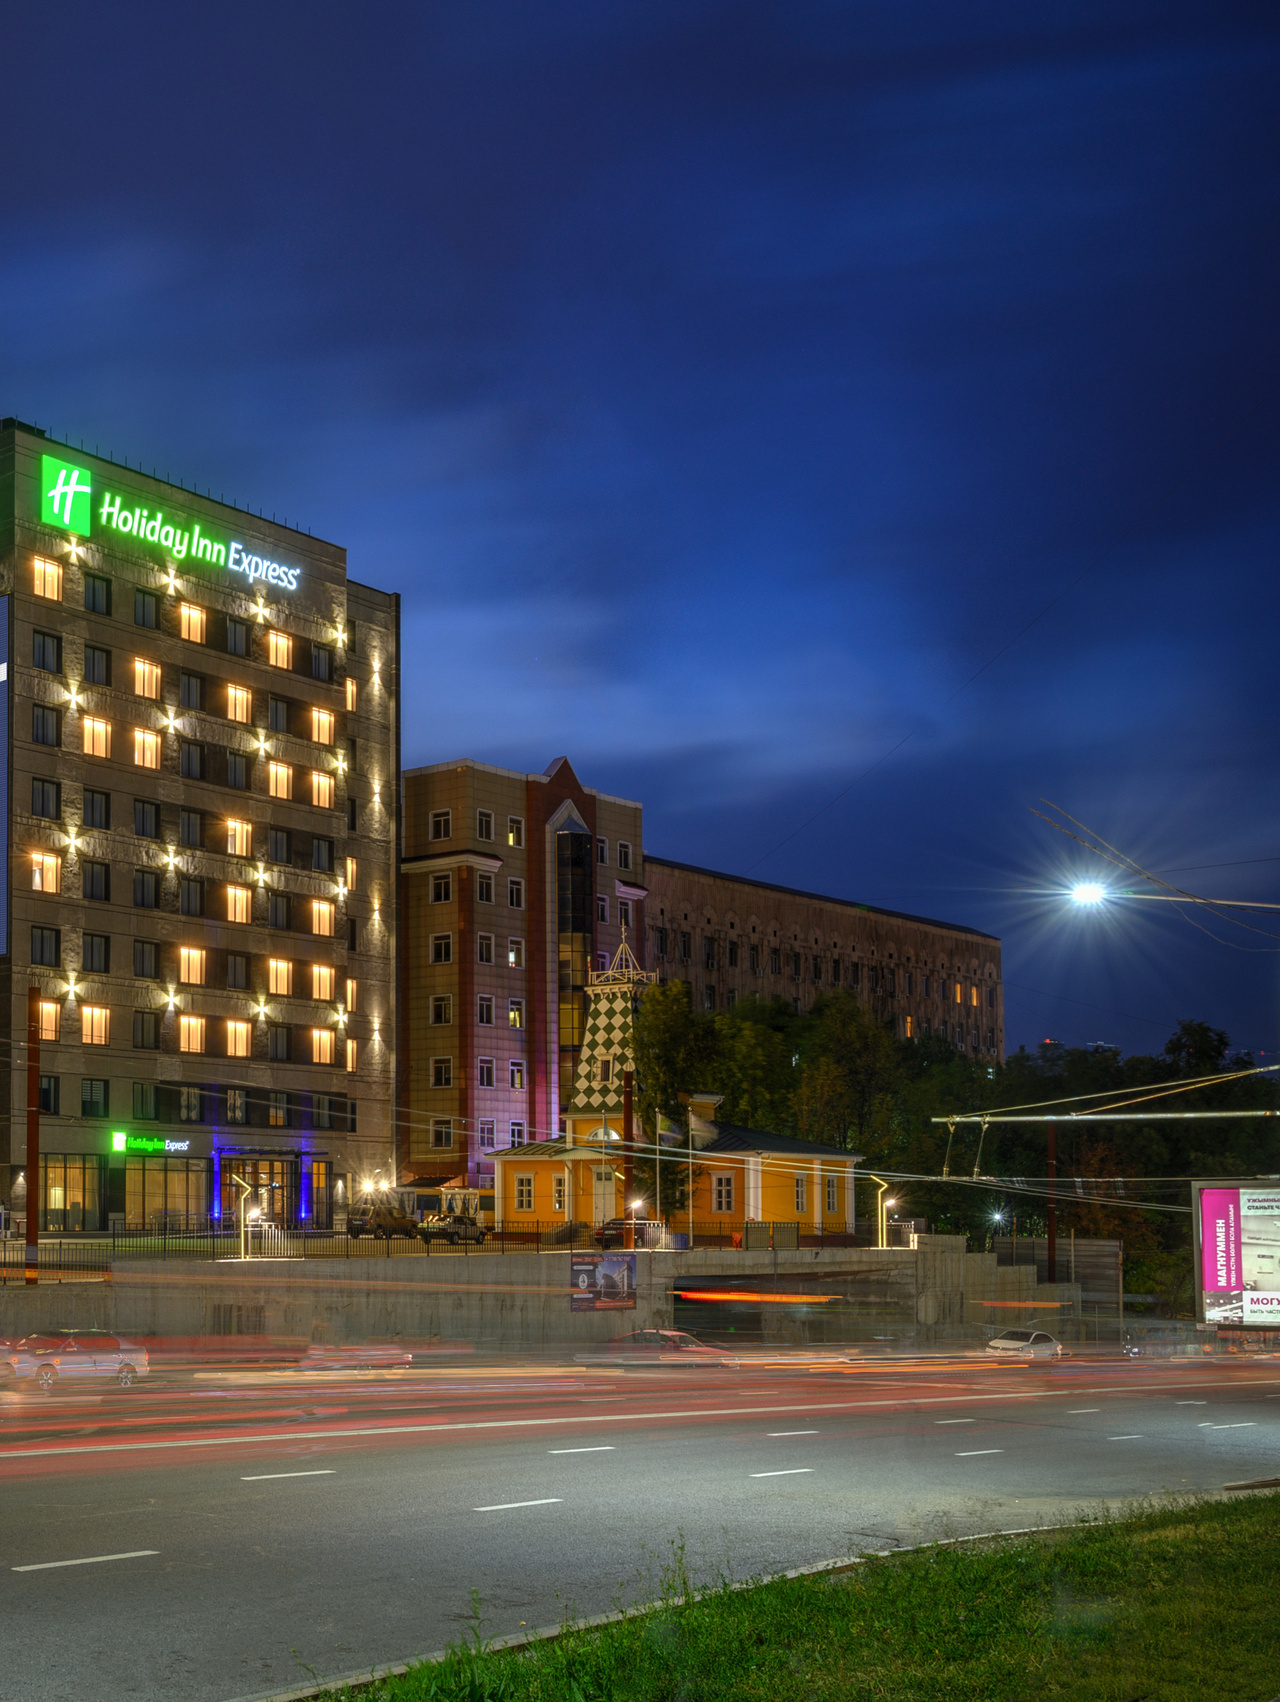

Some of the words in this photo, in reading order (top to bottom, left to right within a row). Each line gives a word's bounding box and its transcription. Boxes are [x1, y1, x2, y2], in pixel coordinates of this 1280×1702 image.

[99, 492, 190, 559] Holiday
[192, 524, 226, 566] Inn
[228, 541, 299, 590] Express
[127, 1136, 154, 1152] Holiday
[165, 1140, 188, 1152] Express
[1216, 1219, 1227, 1287] МАГНУММЕН
